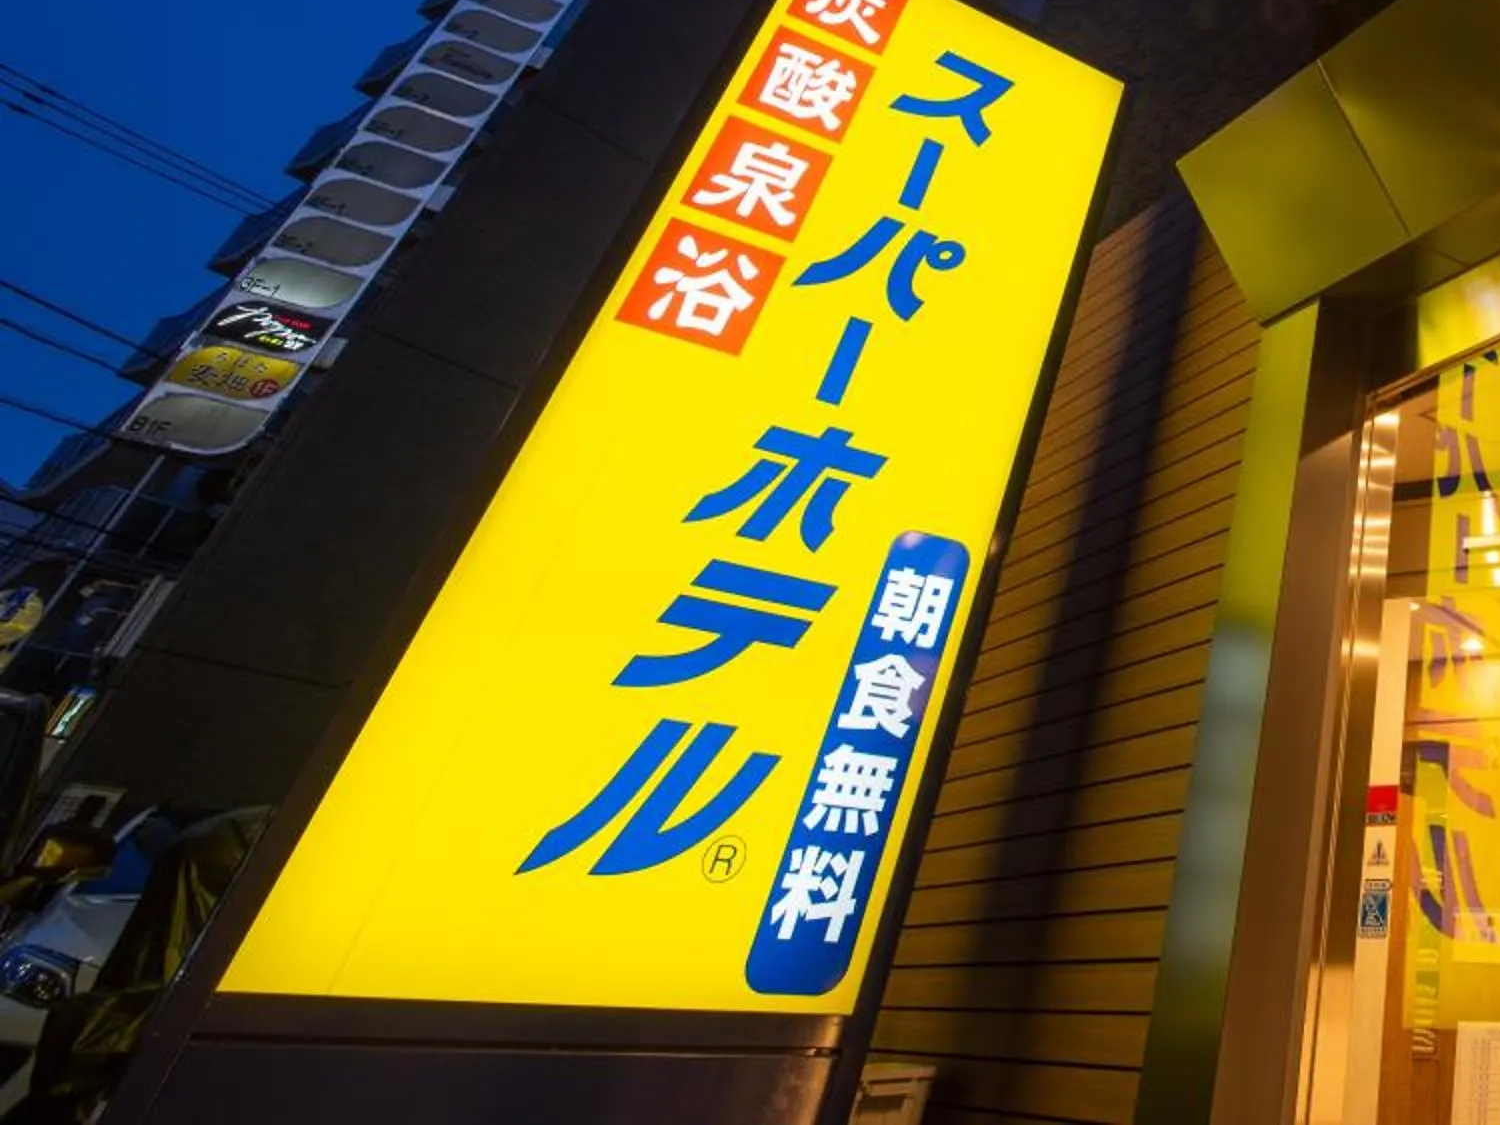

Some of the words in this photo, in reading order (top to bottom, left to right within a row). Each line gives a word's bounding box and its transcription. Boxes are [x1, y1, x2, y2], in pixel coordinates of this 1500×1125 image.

[128, 415, 173, 435] B1F
[513, 50, 1015, 876] スーパーホテル
[770, 565, 953, 944] 朝食無料
